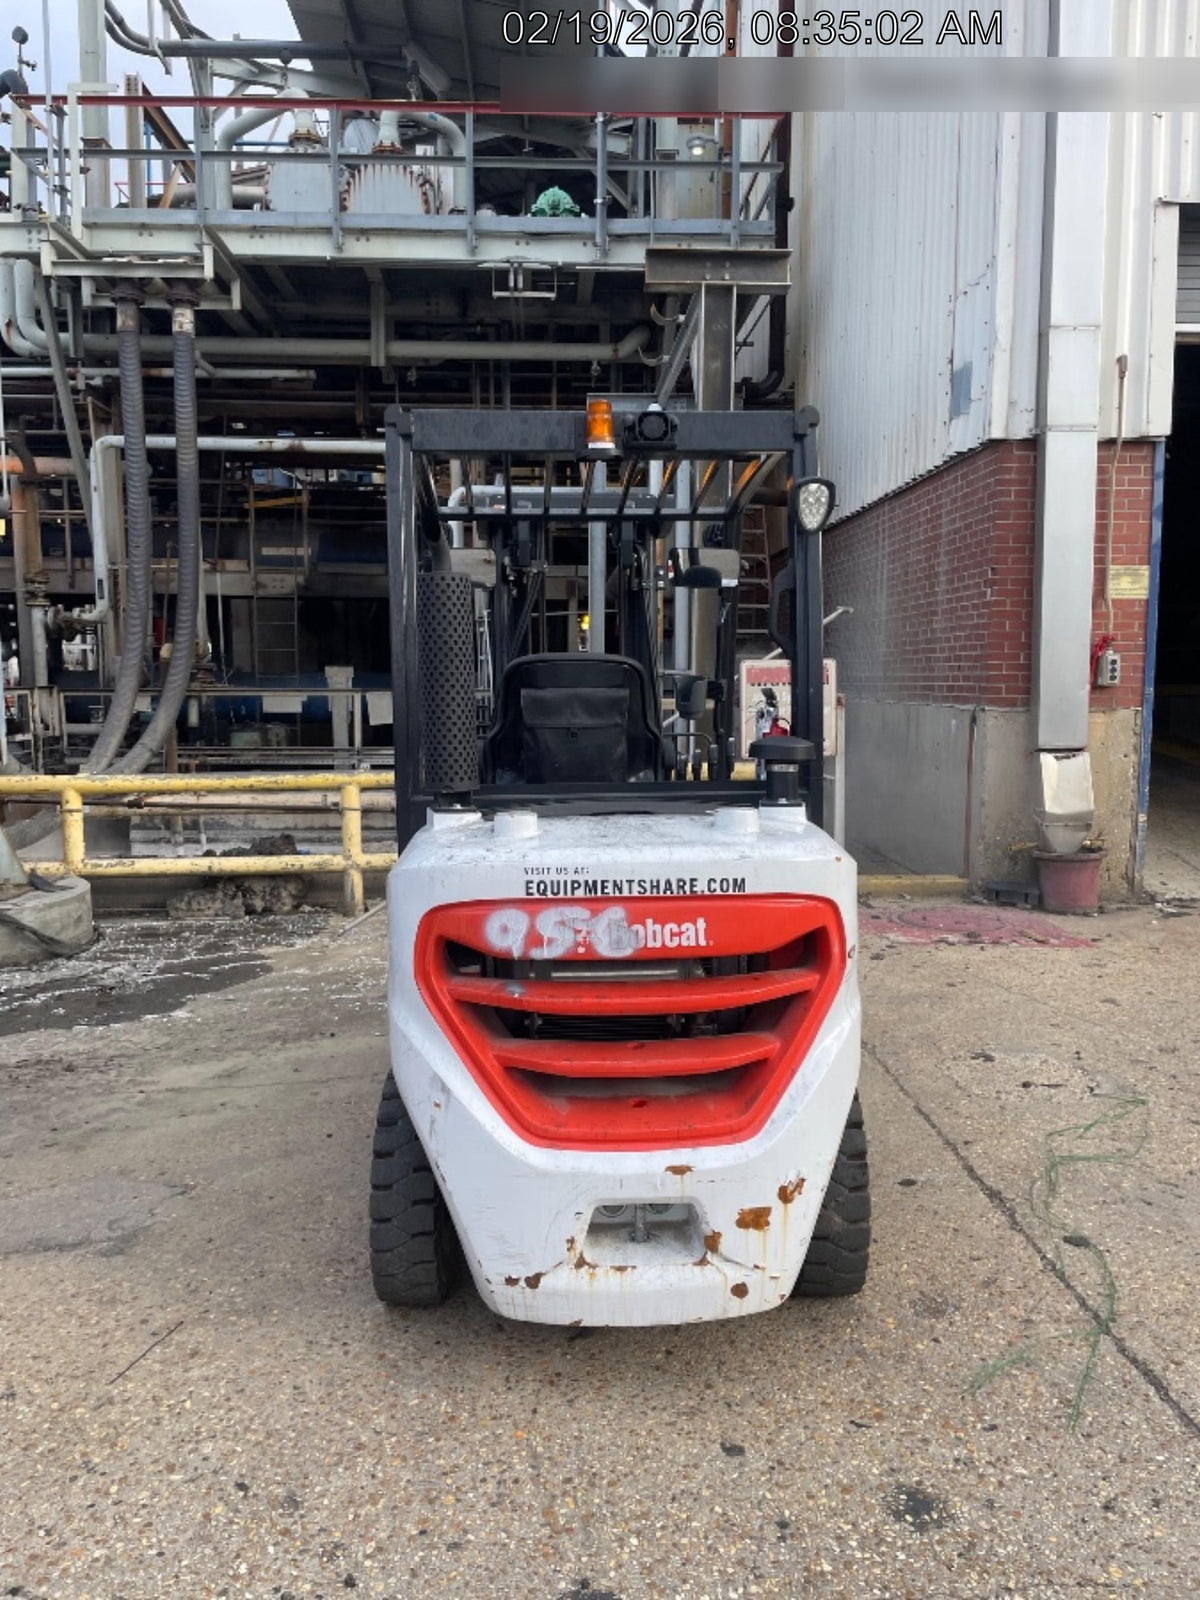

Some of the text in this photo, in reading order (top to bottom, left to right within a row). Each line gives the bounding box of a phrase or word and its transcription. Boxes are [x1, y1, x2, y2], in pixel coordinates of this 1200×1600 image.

[524, 867, 551, 875] VISIT
[556, 867, 569, 875] US
[525, 878, 746, 897] EQUIPMENTSHARE.COM
